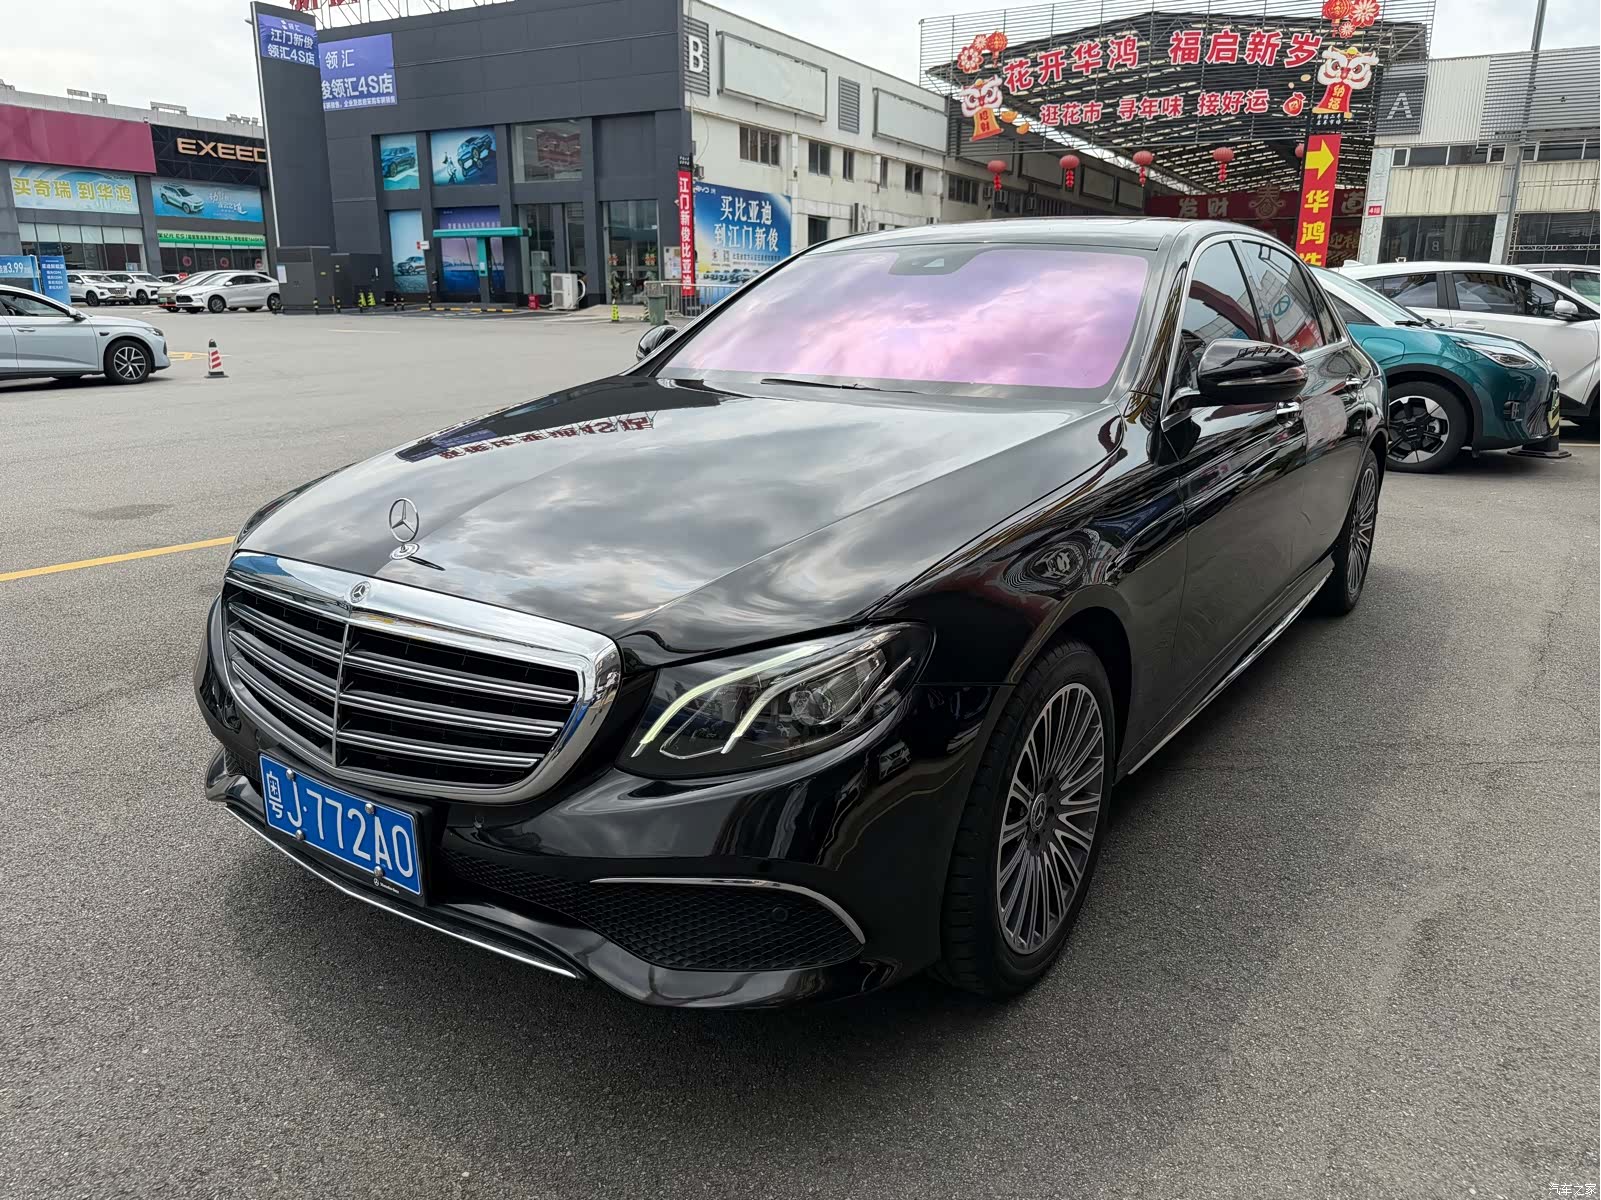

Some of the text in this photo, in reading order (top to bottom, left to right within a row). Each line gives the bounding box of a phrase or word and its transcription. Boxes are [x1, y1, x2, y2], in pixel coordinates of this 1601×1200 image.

[271, 28, 313, 49] 江门新俊
[268, 43, 315, 65] 领汇4S店
[325, 49, 354, 69] 领汇
[688, 35, 704, 73] B
[1003, 29, 1322, 93] 花开华鸿 福启新岁
[1040, 89, 1270, 126] 逛花市 寻年味 接好运
[1328, 84, 1345, 110] 纳福
[1386, 92, 1413, 119] A
[12, 177, 132, 202] 买奇瑞 到华鸿
[720, 195, 772, 225] 买比亚迪
[1179, 197, 1229, 218] 发财
[679, 177, 693, 290] 江门新俊比亚迪
[714, 223, 779, 251] 到江门新俊
